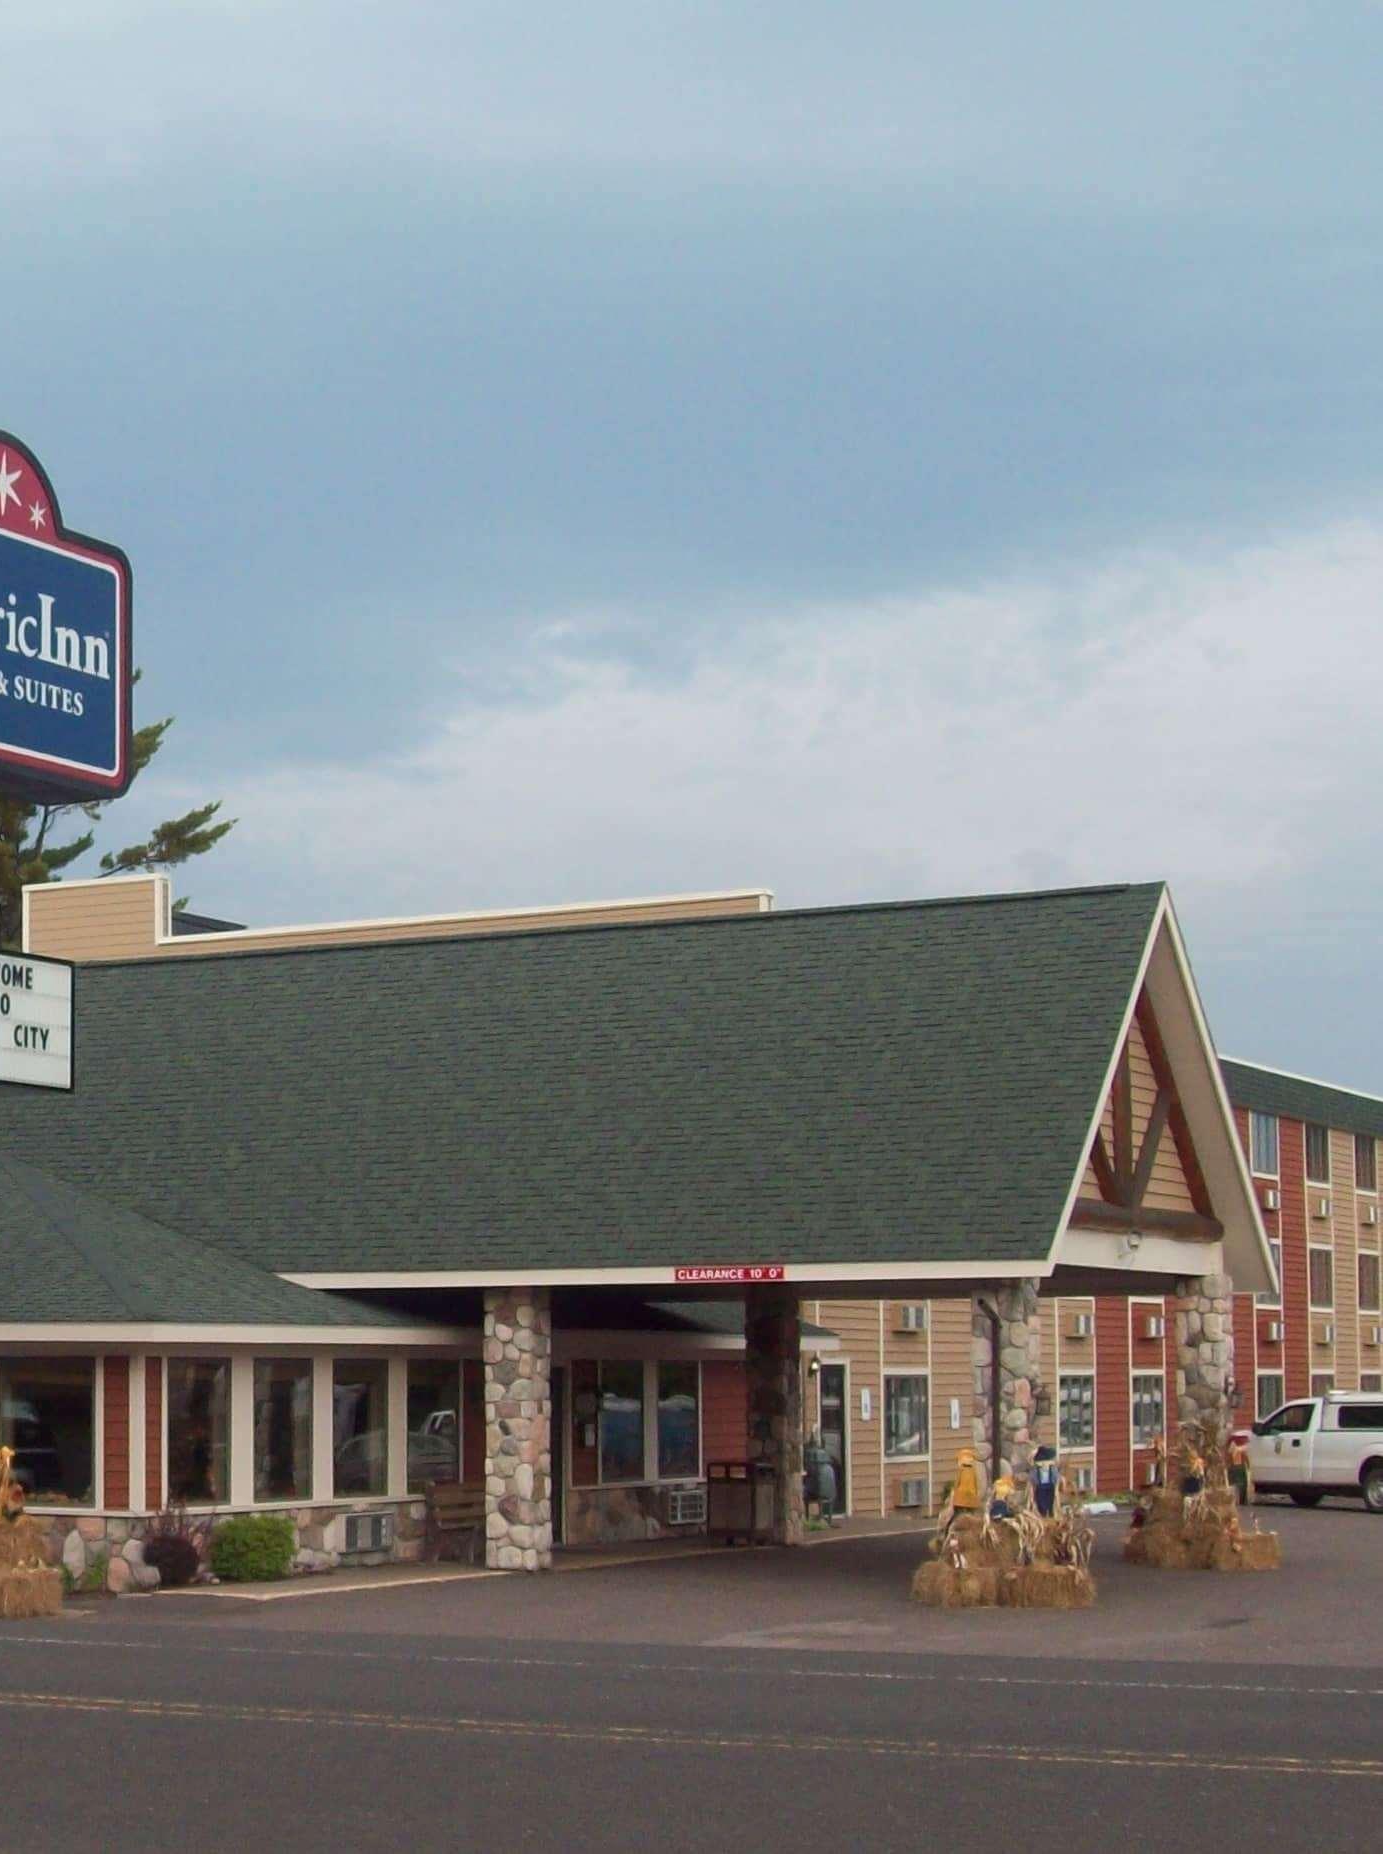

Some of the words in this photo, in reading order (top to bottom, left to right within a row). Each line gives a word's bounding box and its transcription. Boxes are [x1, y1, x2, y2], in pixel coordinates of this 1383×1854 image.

[14, 675, 84, 717] SUITES
[13, 1024, 50, 1050] CITY
[677, 1268, 744, 1281] CLEARANCE
